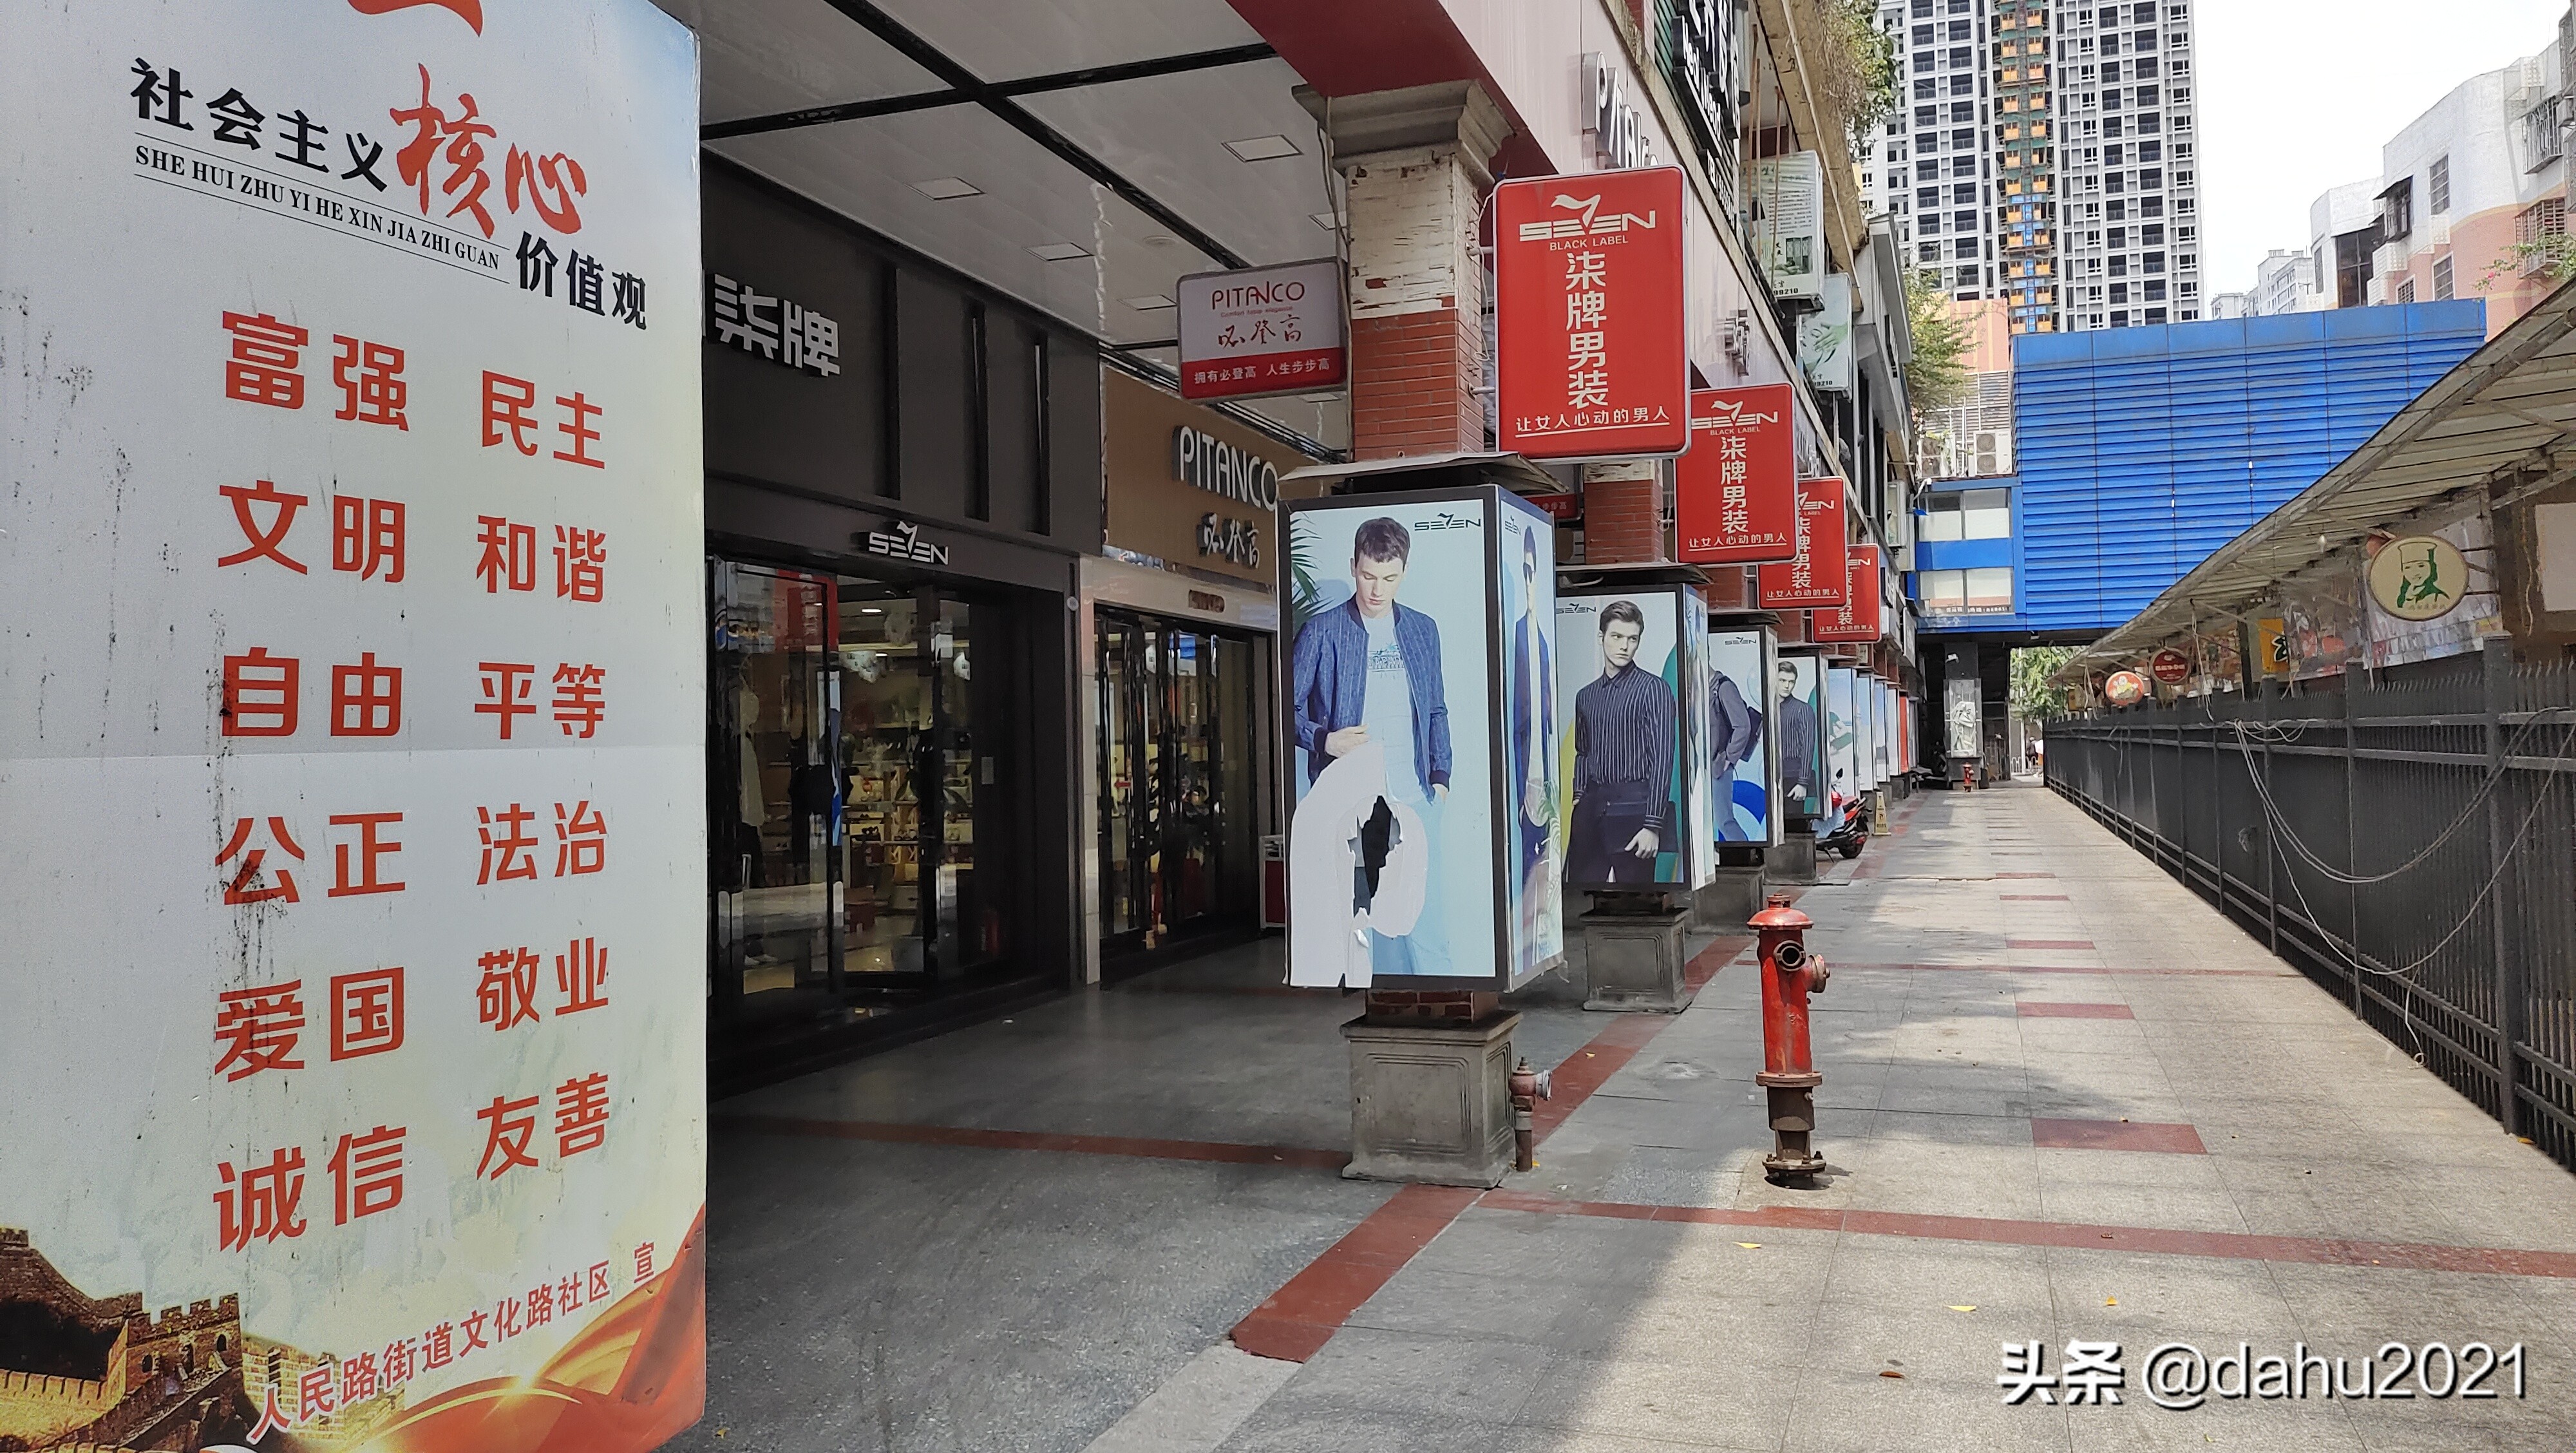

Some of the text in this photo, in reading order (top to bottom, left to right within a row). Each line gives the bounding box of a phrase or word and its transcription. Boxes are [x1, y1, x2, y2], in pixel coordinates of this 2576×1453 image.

[1595, 51, 1658, 168] PITAN
[131, 57, 647, 330] 社会主义 核心 价值观
[136, 146, 499, 270] SHE HUI ZHU YI HE XIN JIA ZHI GUAN
[1520, 195, 1656, 242] SEVEN
[1549, 234, 1629, 251] BLACK LABEL
[715, 274, 840, 376] 柒牌
[1212, 281, 1305, 310] PITANCO
[1566, 251, 1608, 409] 柒牌男装
[223, 312, 605, 469] 富强 民主
[1194, 357, 1330, 384] 拥有必登高 人生步步高
[1691, 401, 1778, 430] SEVEN
[1516, 406, 1669, 432] 让女人心动的男人
[1180, 426, 1278, 512] PITANCO
[1720, 435, 1748, 534] 柒牌男装
[219, 480, 607, 603] 文明 和谐
[869, 521, 949, 565] SEVEN
[1414, 513, 1481, 531] SEVEN
[1689, 532, 1787, 548] 让女人心动的男人
[1556, 603, 1596, 614] SEVEN
[1766, 588, 1840, 598] 让女人心动的男人
[223, 647, 606, 740] 自由 平等
[215, 801, 607, 906] 公正 法治
[214, 937, 609, 1083] 爱国 敬业
[213, 1072, 609, 1253] 诚信 友善
[251, 1242, 656, 1441] 人民路街道文化路社区 宣
